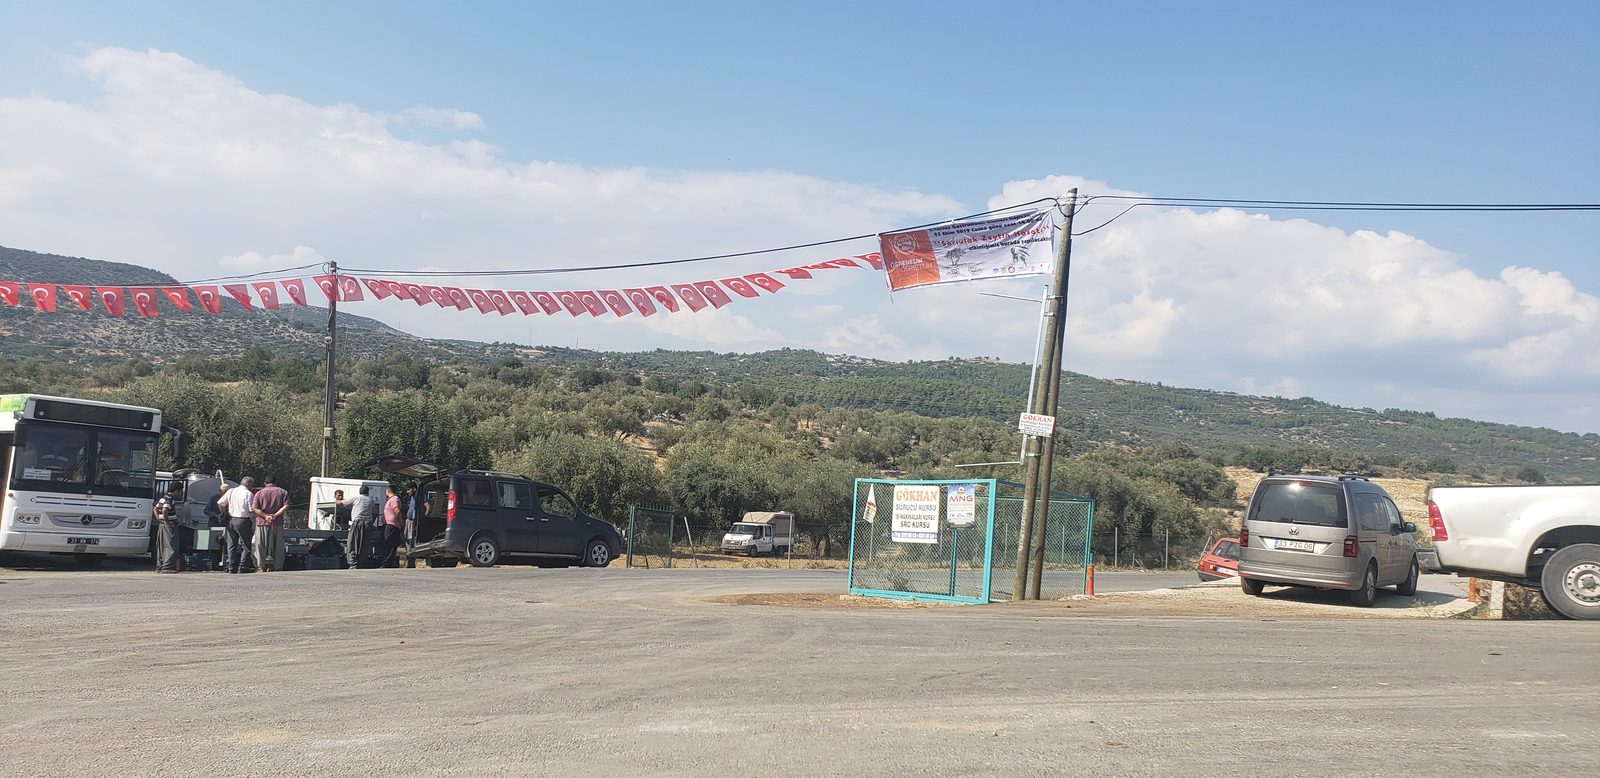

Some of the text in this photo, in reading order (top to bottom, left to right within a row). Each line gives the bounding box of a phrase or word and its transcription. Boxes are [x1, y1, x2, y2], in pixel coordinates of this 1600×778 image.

[896, 489, 937, 501] GÖKHAN
[918, 504, 937, 512] KURSU
[912, 521, 930, 529] KURSU
[1289, 541, 1303, 549] PZG
